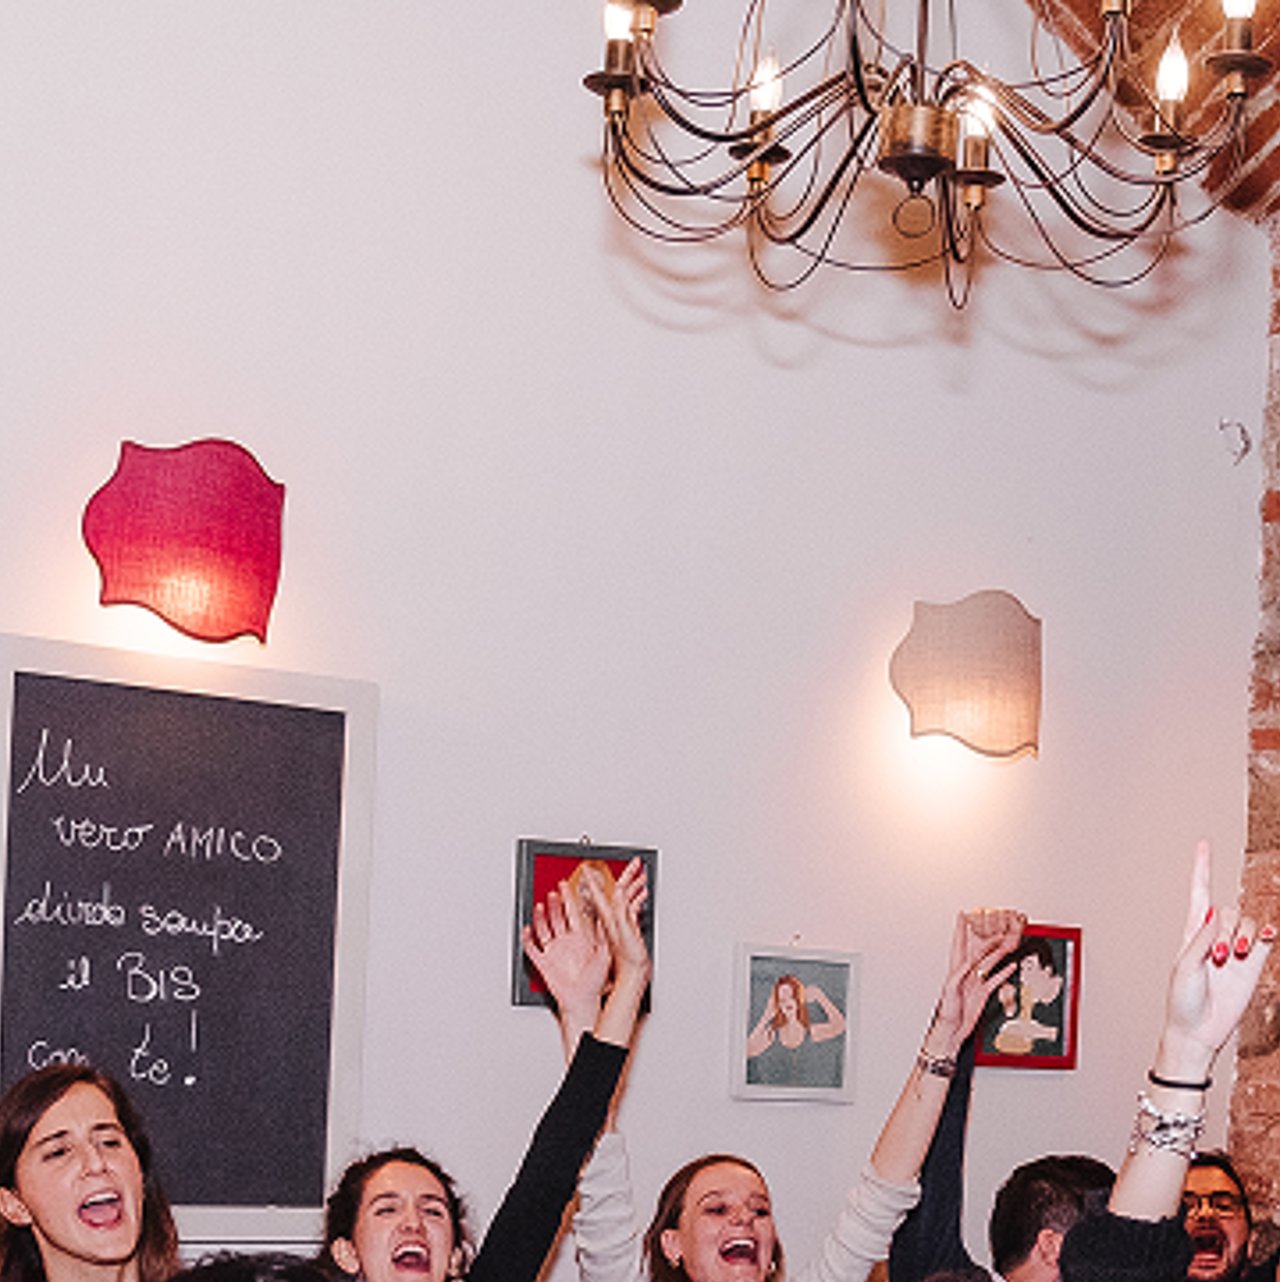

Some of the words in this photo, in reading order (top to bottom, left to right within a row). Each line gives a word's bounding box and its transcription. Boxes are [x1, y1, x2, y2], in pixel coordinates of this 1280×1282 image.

[50, 816, 154, 851] vero
[164, 820, 282, 863] AMICO
[116, 951, 201, 1002] BIS
